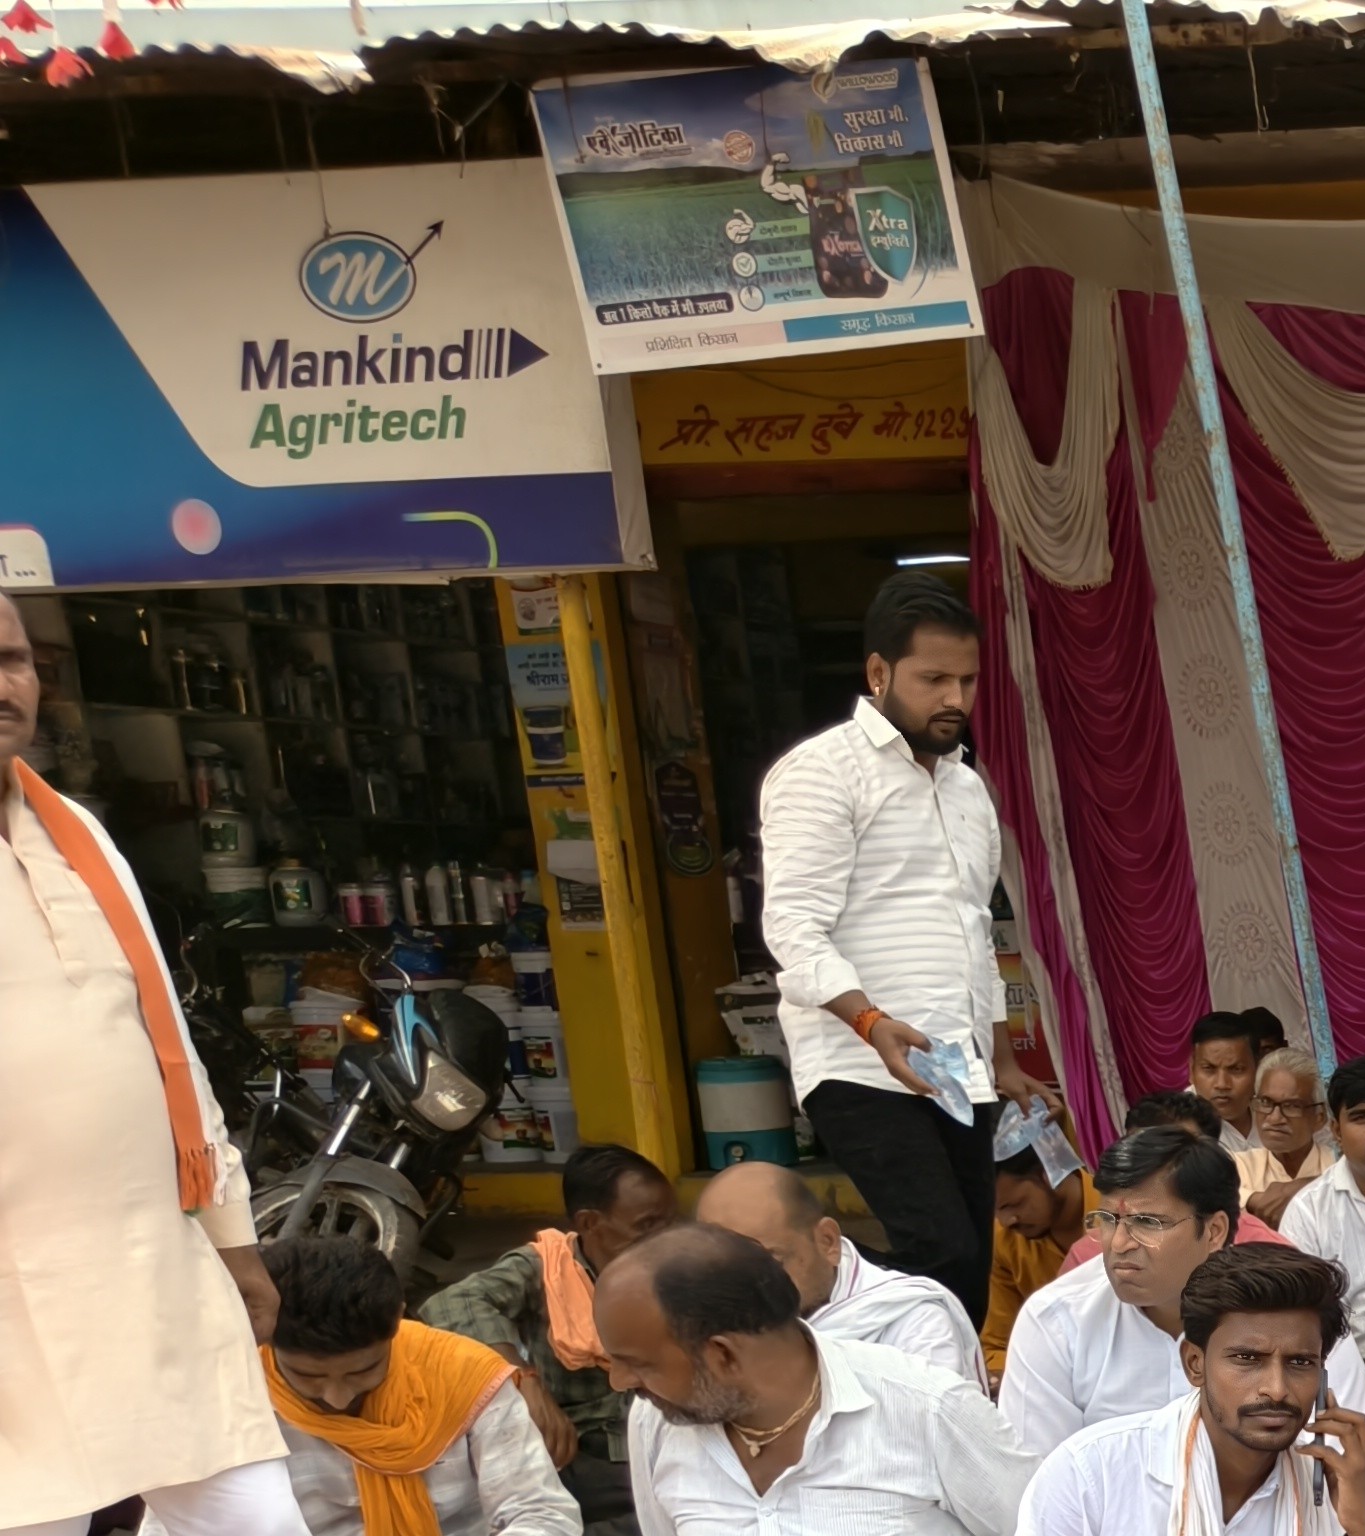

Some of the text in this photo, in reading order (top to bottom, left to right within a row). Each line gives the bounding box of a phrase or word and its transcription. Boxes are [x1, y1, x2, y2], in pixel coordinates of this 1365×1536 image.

[844, 109, 886, 133] सुरक्षा
[834, 130, 904, 153] विकास भी
[866, 209, 908, 232] Xtra
[241, 328, 474, 391] Mankind
[250, 394, 467, 459] Agritech
[725, 413, 806, 457] सहज
[811, 402, 864, 455] दुबे
